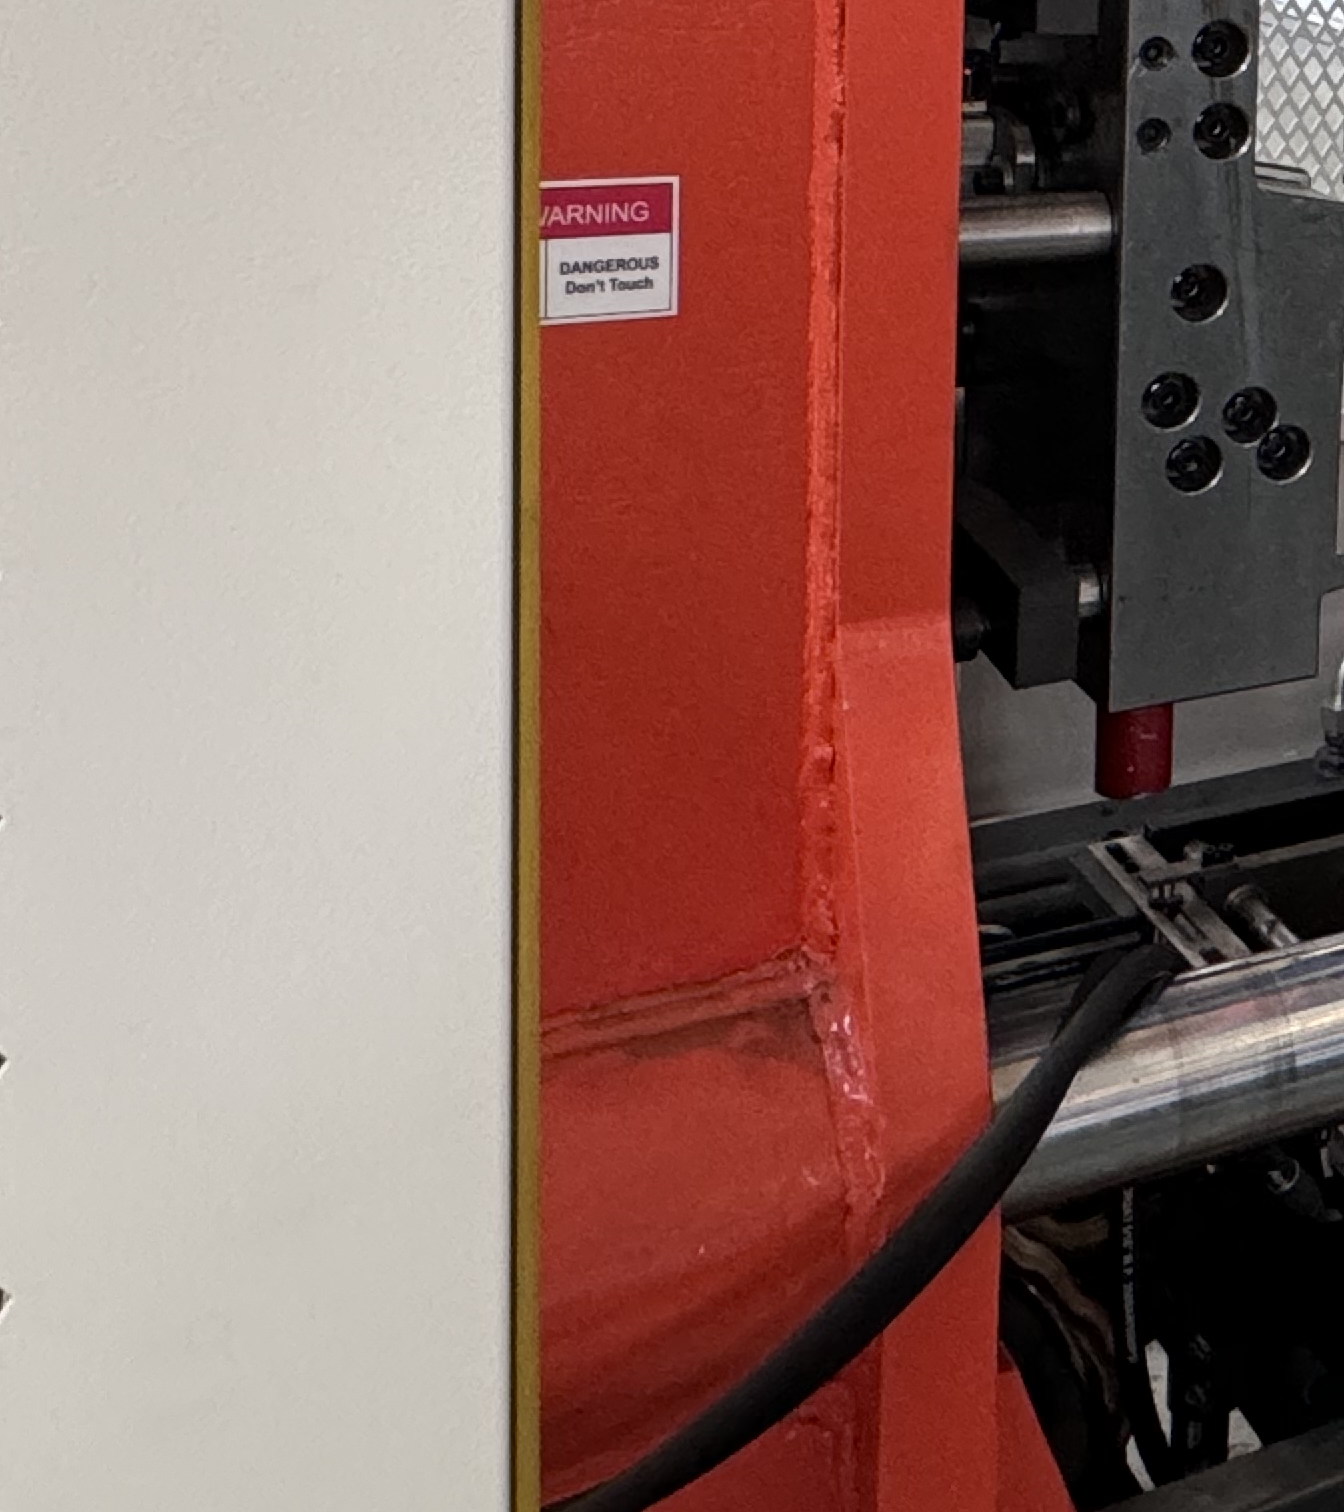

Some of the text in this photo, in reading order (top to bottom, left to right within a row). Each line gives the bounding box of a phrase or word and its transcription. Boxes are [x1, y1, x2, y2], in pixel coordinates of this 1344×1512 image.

[559, 256, 660, 276] DANGEROUS
[565, 276, 654, 295] Don't Touch
